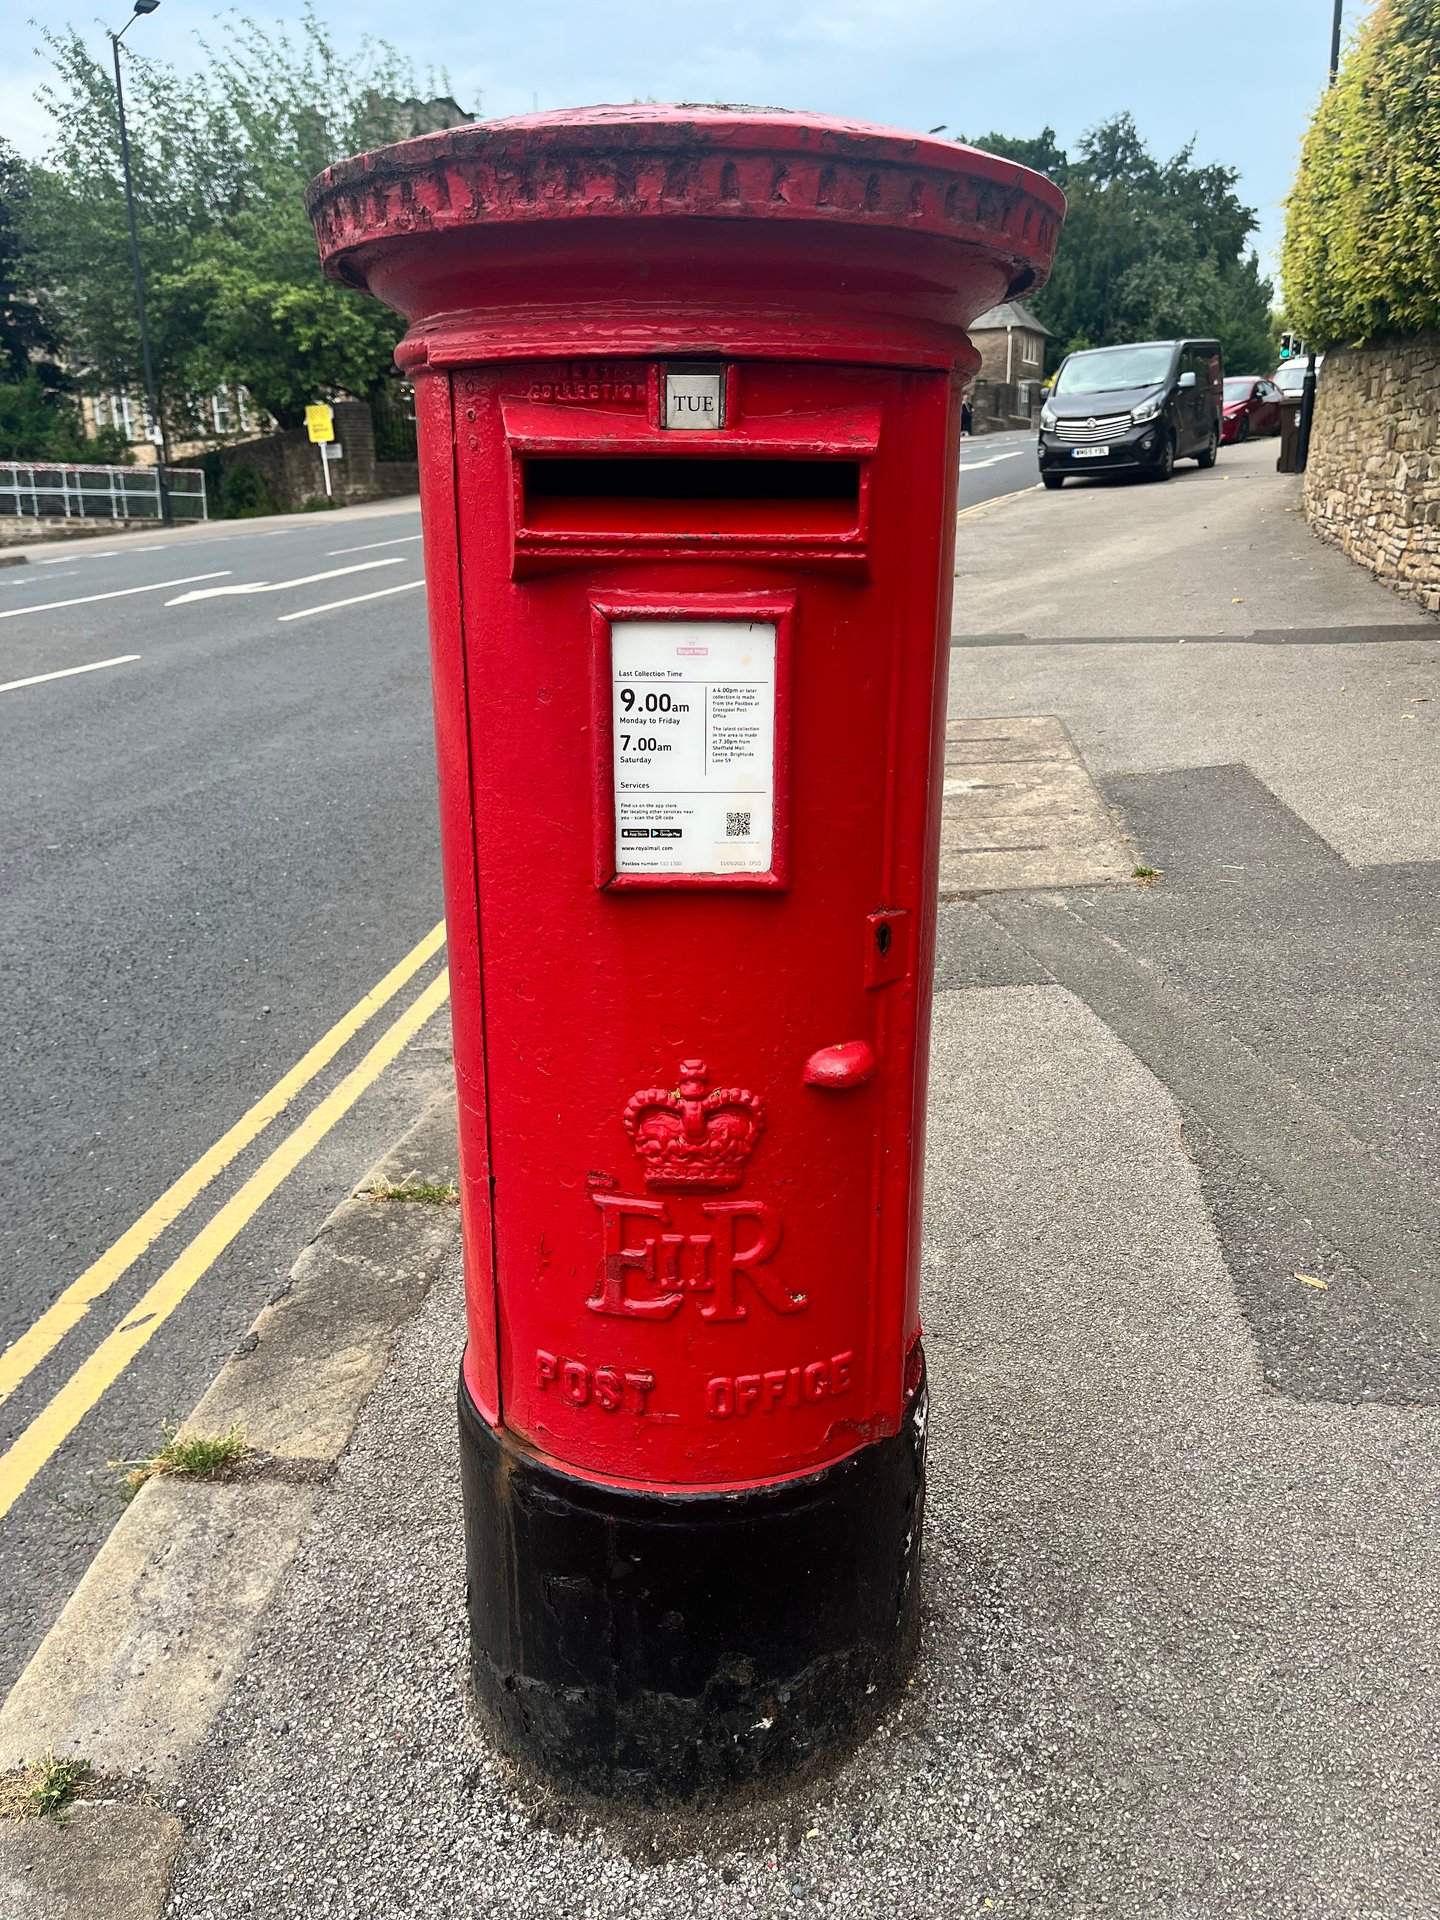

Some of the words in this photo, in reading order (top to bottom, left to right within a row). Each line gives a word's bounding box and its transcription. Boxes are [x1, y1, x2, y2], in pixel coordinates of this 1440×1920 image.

[674, 396, 714, 412] TUE
[620, 688, 689, 712] 9.00am
[659, 717, 680, 725] Friday
[620, 735, 672, 751] 7.00am
[620, 756, 651, 764] Saturday
[536, 1348, 656, 1415] POST
[705, 1350, 853, 1419] OFFICE
